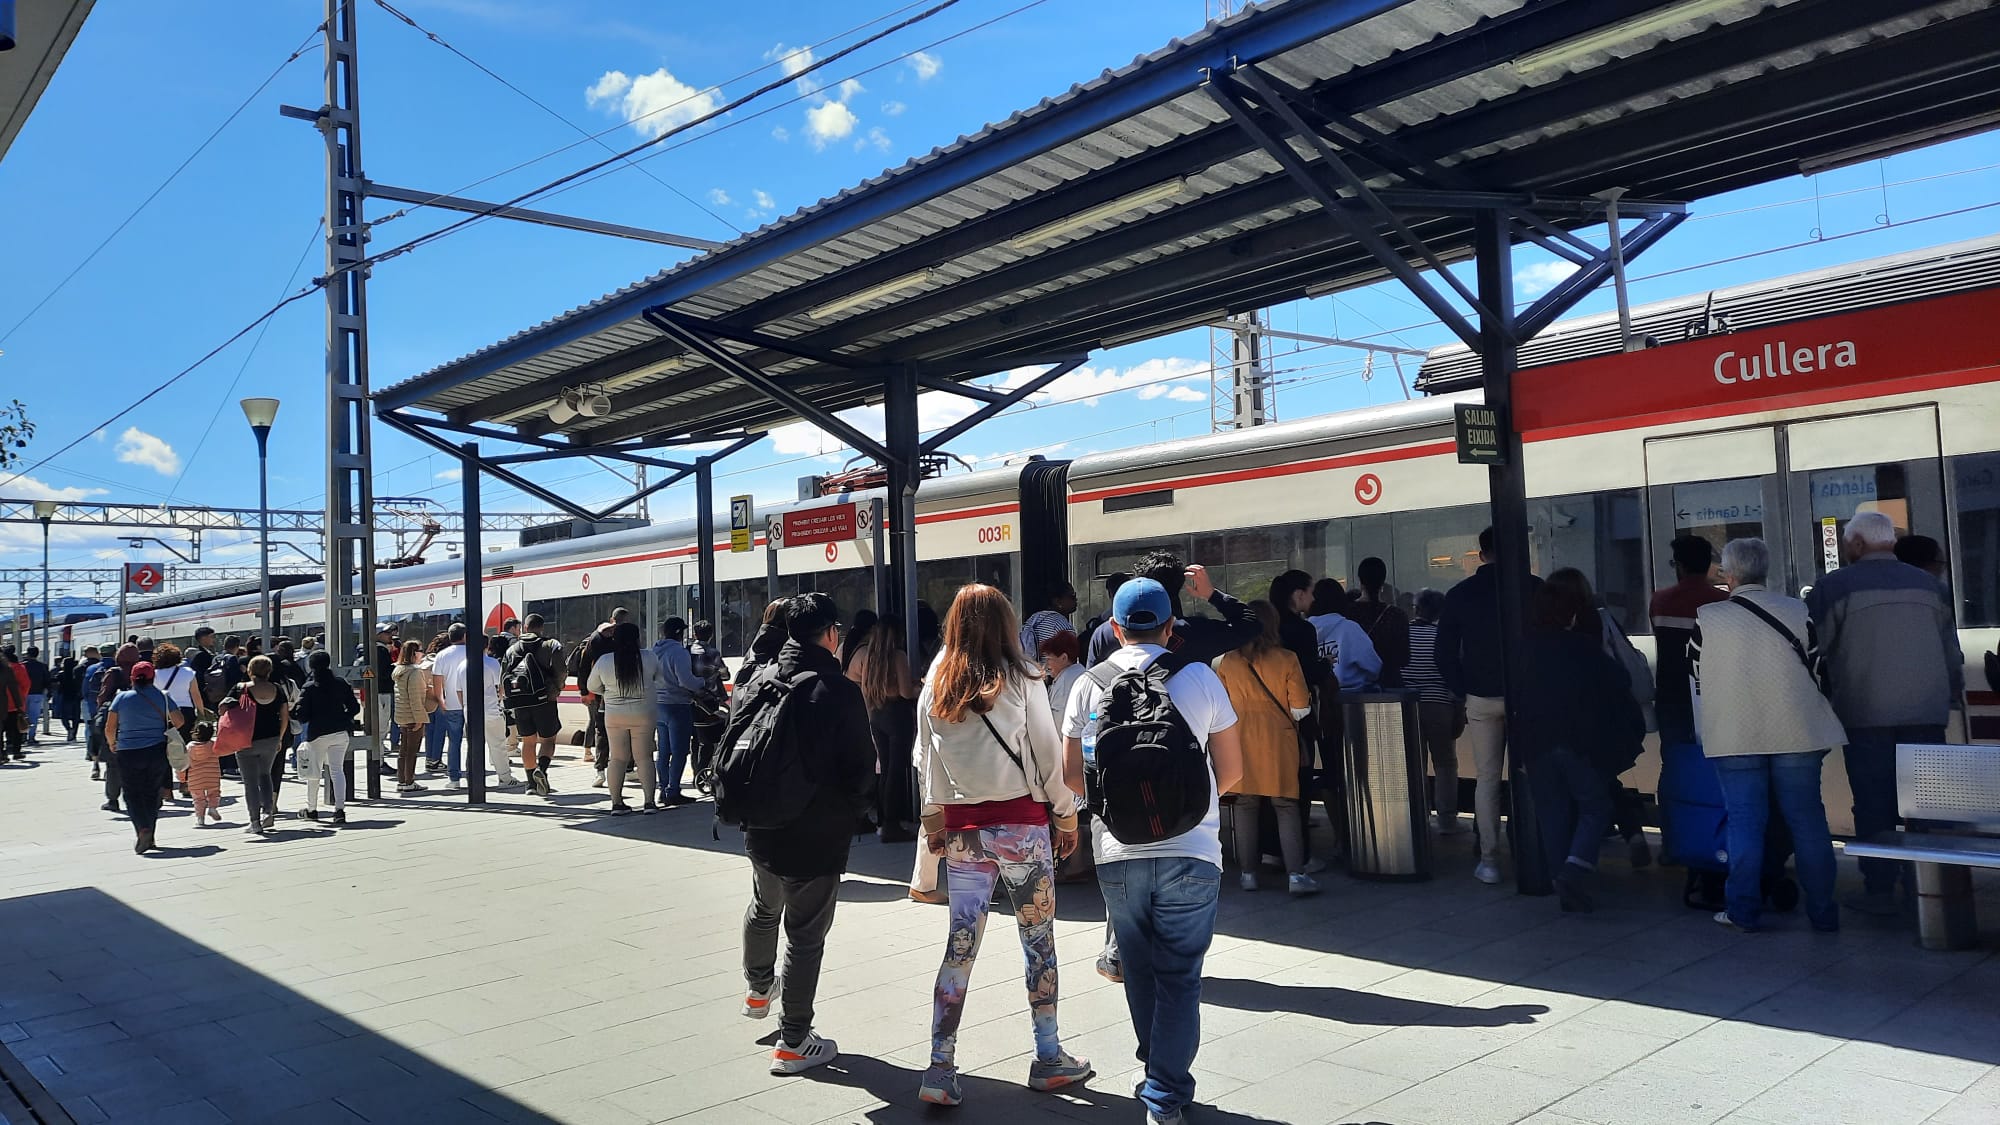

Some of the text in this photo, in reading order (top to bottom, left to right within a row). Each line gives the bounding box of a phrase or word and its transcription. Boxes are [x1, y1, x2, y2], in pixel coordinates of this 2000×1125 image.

[1713, 339, 1857, 385] Cullera
[1464, 408, 1497, 426] SALIDA
[1467, 428, 1497, 446] EIXIDA
[978, 524, 1011, 544] 003R
[140, 570, 153, 586] 2
